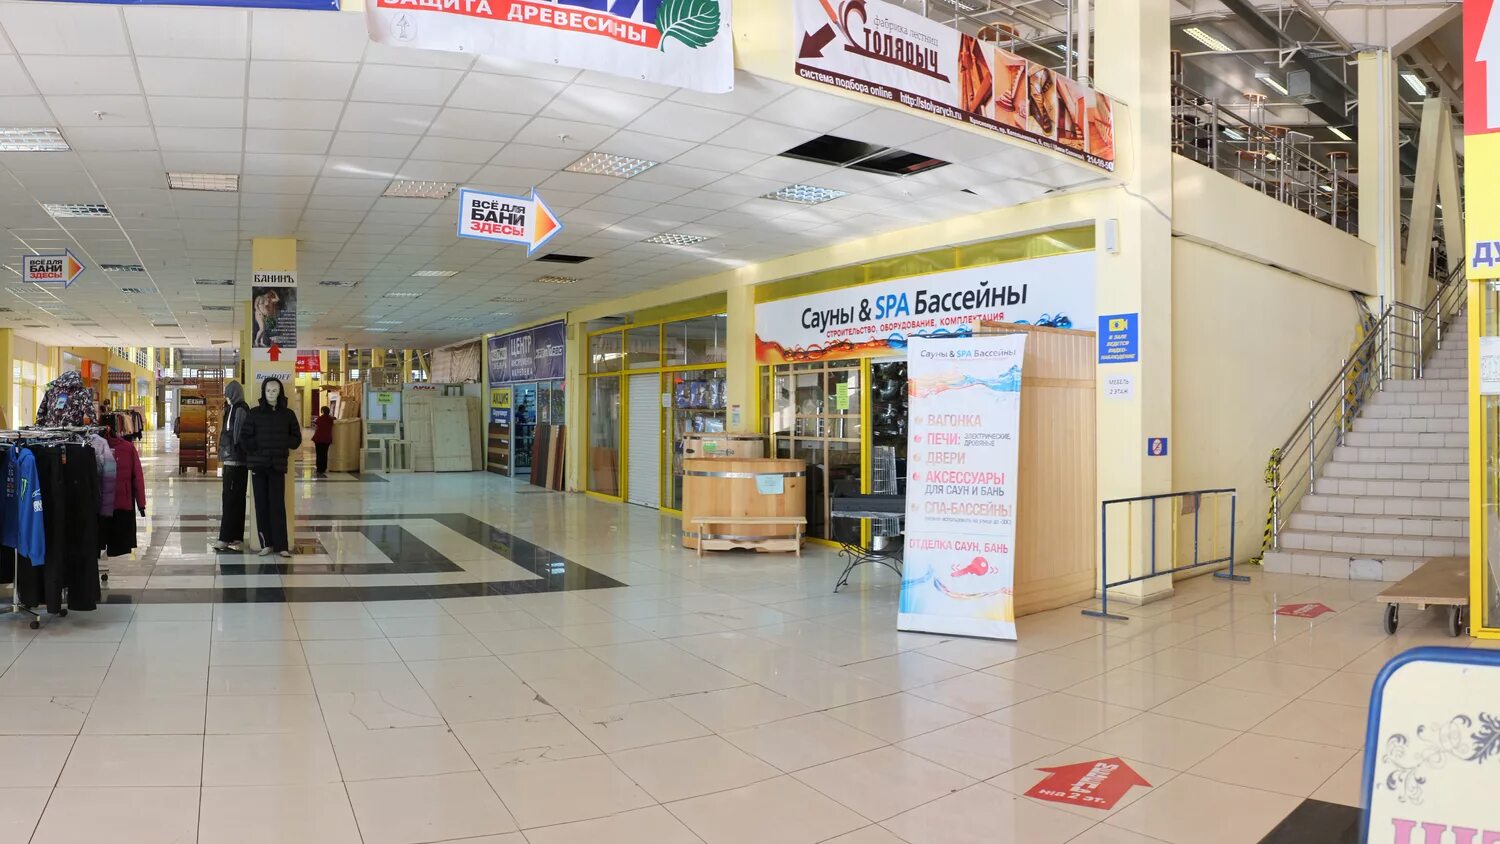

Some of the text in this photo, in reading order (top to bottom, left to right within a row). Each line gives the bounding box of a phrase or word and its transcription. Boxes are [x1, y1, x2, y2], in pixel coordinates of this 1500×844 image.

[507, 4, 647, 43] ДРЕВЕСИНЫ
[800, 68, 834, 84] система
[835, 77, 869, 93] подбора
[870, 86, 893, 99] online
[472, 199, 526, 214] ВСЁ ДЛЯ
[471, 208, 525, 227] БАНИ
[470, 221, 524, 237] ЗДЕСЬ!
[801, 280, 1028, 334] Сауны & SPA Бассейны
[920, 350, 948, 359] Сауны
[956, 350, 972, 358] SPA
[974, 348, 1016, 358] Бассейны
[927, 414, 982, 427] ВАГОНКА
[927, 432, 961, 446] ПЕЧИ:
[926, 451, 966, 465] ДВЕРИ
[926, 470, 1005, 485] АКСЕССУАРЫ
[925, 485, 1005, 497] ДЛЯ САУН И БАНЬ
[925, 501, 1012, 517] СПА-БАССЕЙНЫ
[909, 539, 953, 550] ОТДЕЛКА
[984, 542, 1009, 554] БАНЬ
